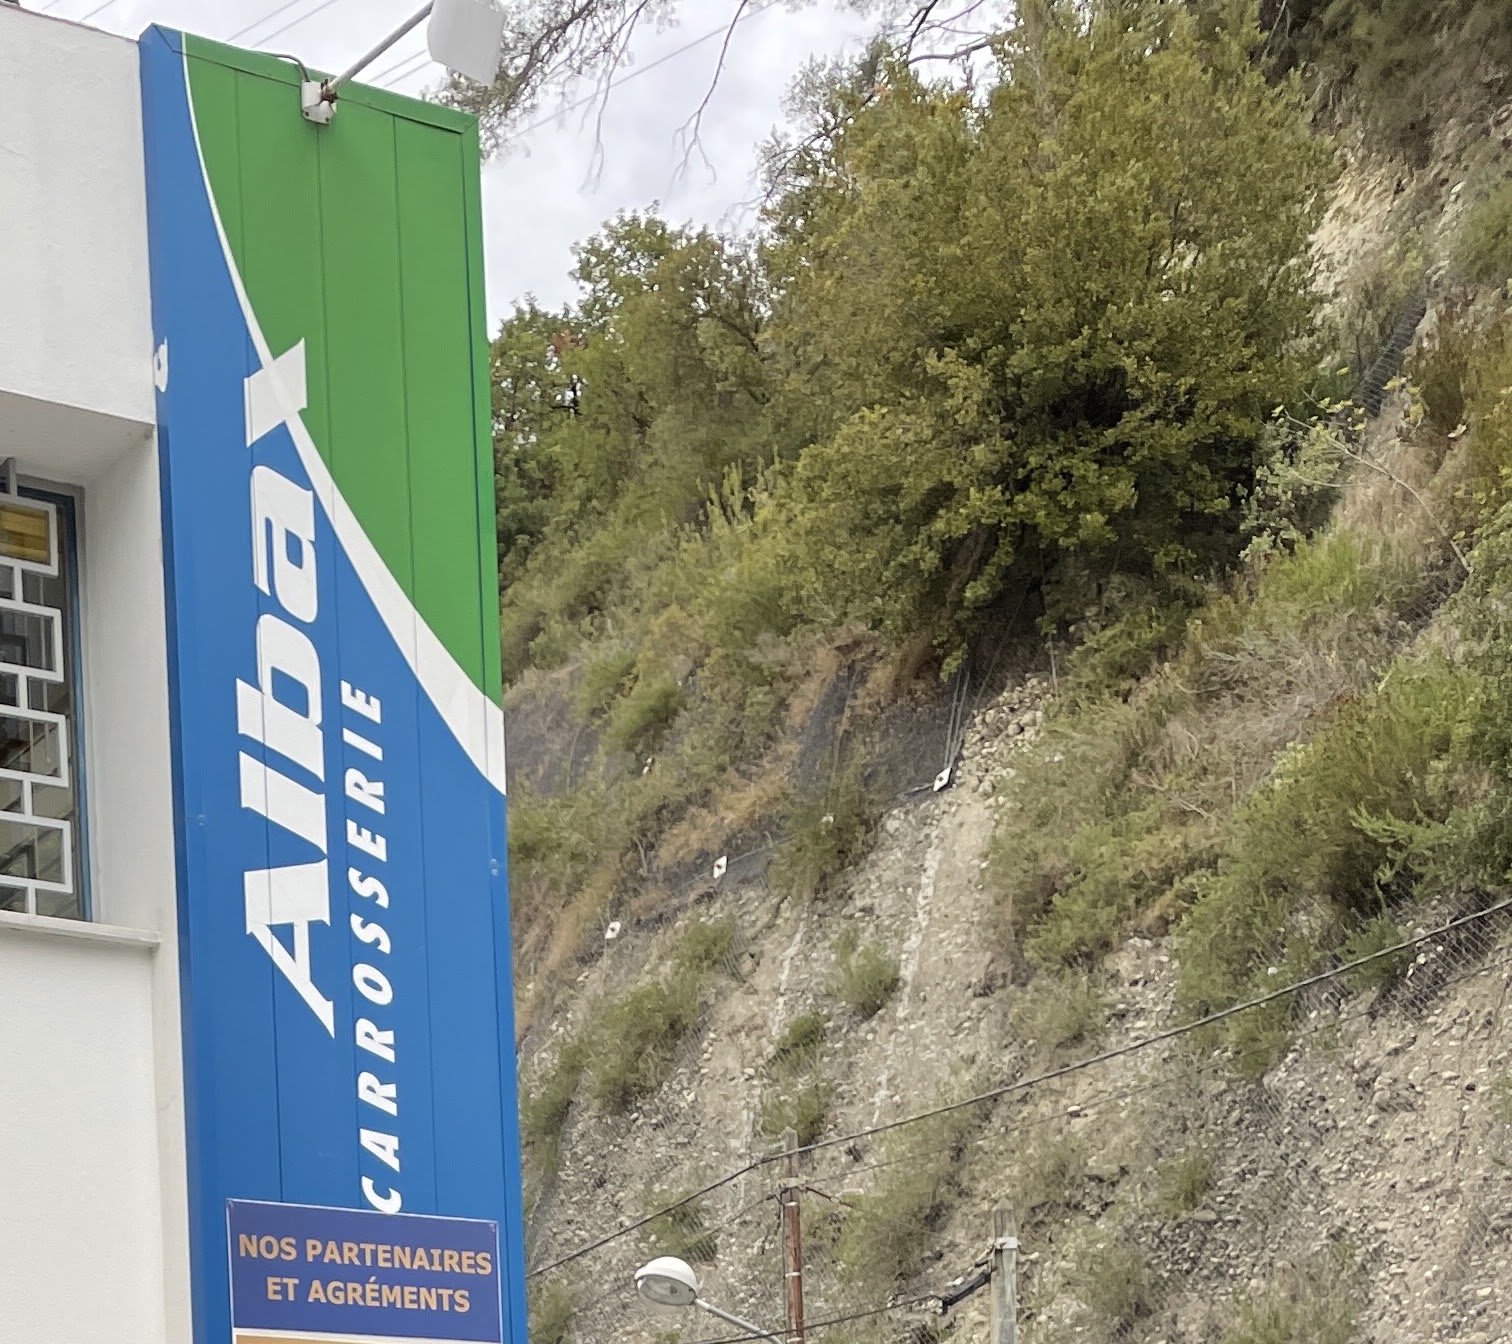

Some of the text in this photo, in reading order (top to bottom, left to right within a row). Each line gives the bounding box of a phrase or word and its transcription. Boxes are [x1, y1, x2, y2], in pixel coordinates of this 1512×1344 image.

[236, 337, 334, 1039] Albax
[340, 679, 403, 1214] CARROSSERIE
[239, 1233, 492, 1275] NOS PARTENAIRES
[267, 1275, 471, 1313] ET AGRÉMENTS
